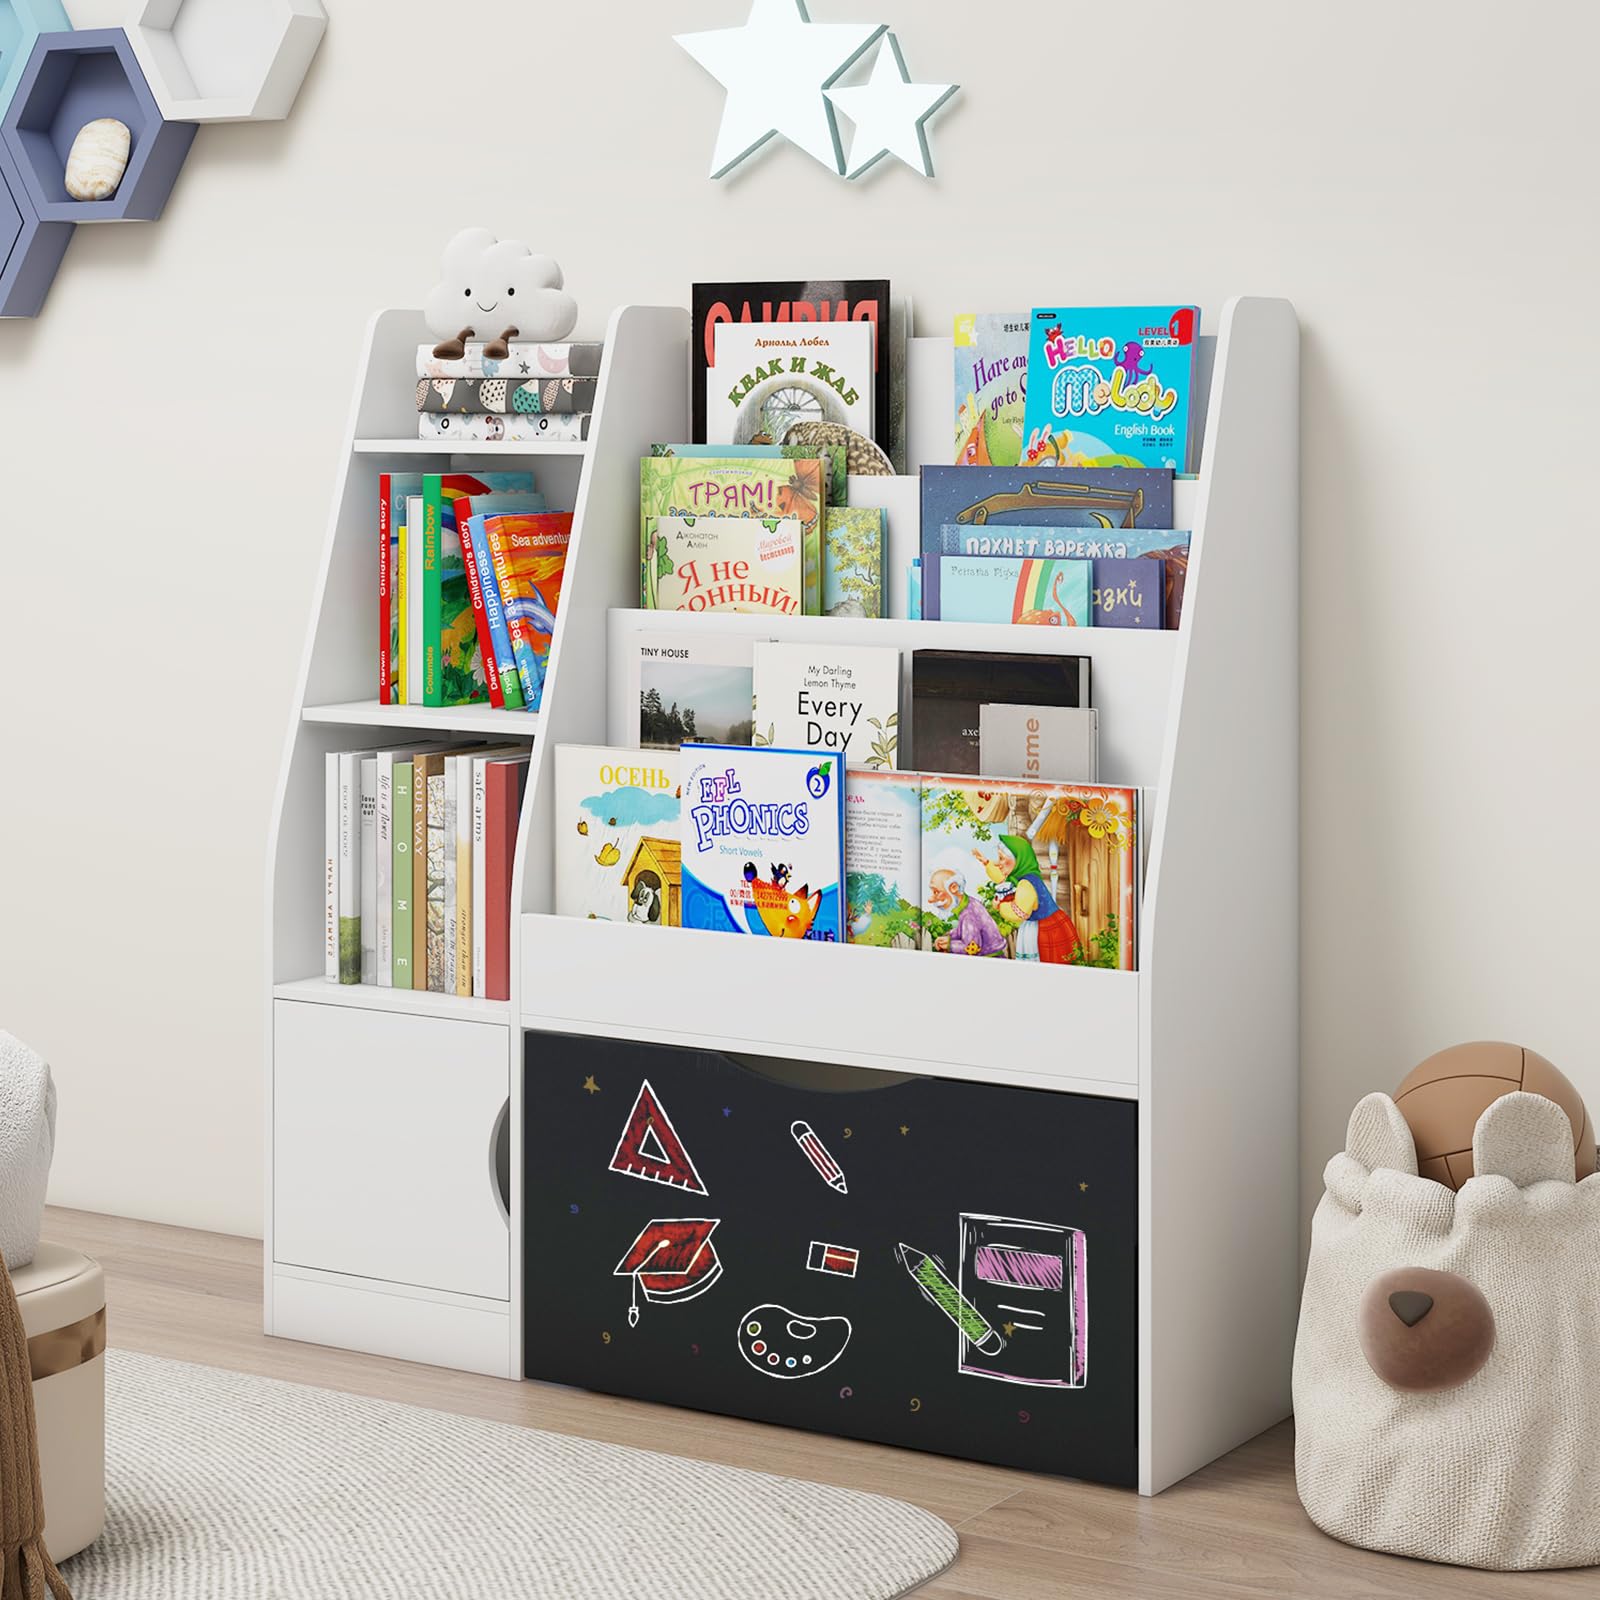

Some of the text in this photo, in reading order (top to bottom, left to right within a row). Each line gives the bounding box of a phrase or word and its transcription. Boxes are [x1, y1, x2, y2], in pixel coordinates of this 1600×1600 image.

[754, 336, 830, 348] Арнольд Лобел
[1138, 320, 1179, 336] LEVEL 1
[1045, 337, 1115, 367] HELLO
[728, 356, 860, 407] КВАК И ЖАБ
[973, 357, 1010, 394] Hare
[1012, 355, 1029, 369] an
[991, 395, 1004, 421] go
[1006, 387, 1018, 405] to
[1114, 423, 1175, 438] English Book
[688, 479, 774, 509] ТРЯМ!
[379, 498, 388, 597] Children's story
[425, 503, 437, 571] Rainbow
[511, 533, 530, 547] Sea
[460, 519, 483, 610] Children's story
[677, 559, 749, 596] Я не
[477, 549, 501, 630] Happiness
[490, 532, 525, 652] Sea adventures
[676, 584, 798, 616] онный!
[379, 650, 387, 686] Darwin
[641, 648, 689, 658] TINY HOUSE
[425, 646, 434, 695] Columbia
[486, 657, 498, 690] Darwin
[804, 678, 856, 691] Lemon Thyme
[808, 665, 852, 678] My Darling
[798, 691, 863, 726] Every
[807, 721, 853, 753] Day
[379, 775, 390, 790] life
[475, 772, 485, 801] safe
[599, 765, 671, 789] ОСЕНЬ
[700, 769, 741, 803] EFL
[814, 778, 821, 792] 2
[361, 794, 375, 802] love
[415, 766, 423, 855] YOUR WAY
[378, 811, 390, 840] flower
[691, 798, 810, 852] PHONICS
[719, 844, 763, 857] Short Vowels
[397, 785, 407, 966] HOME
